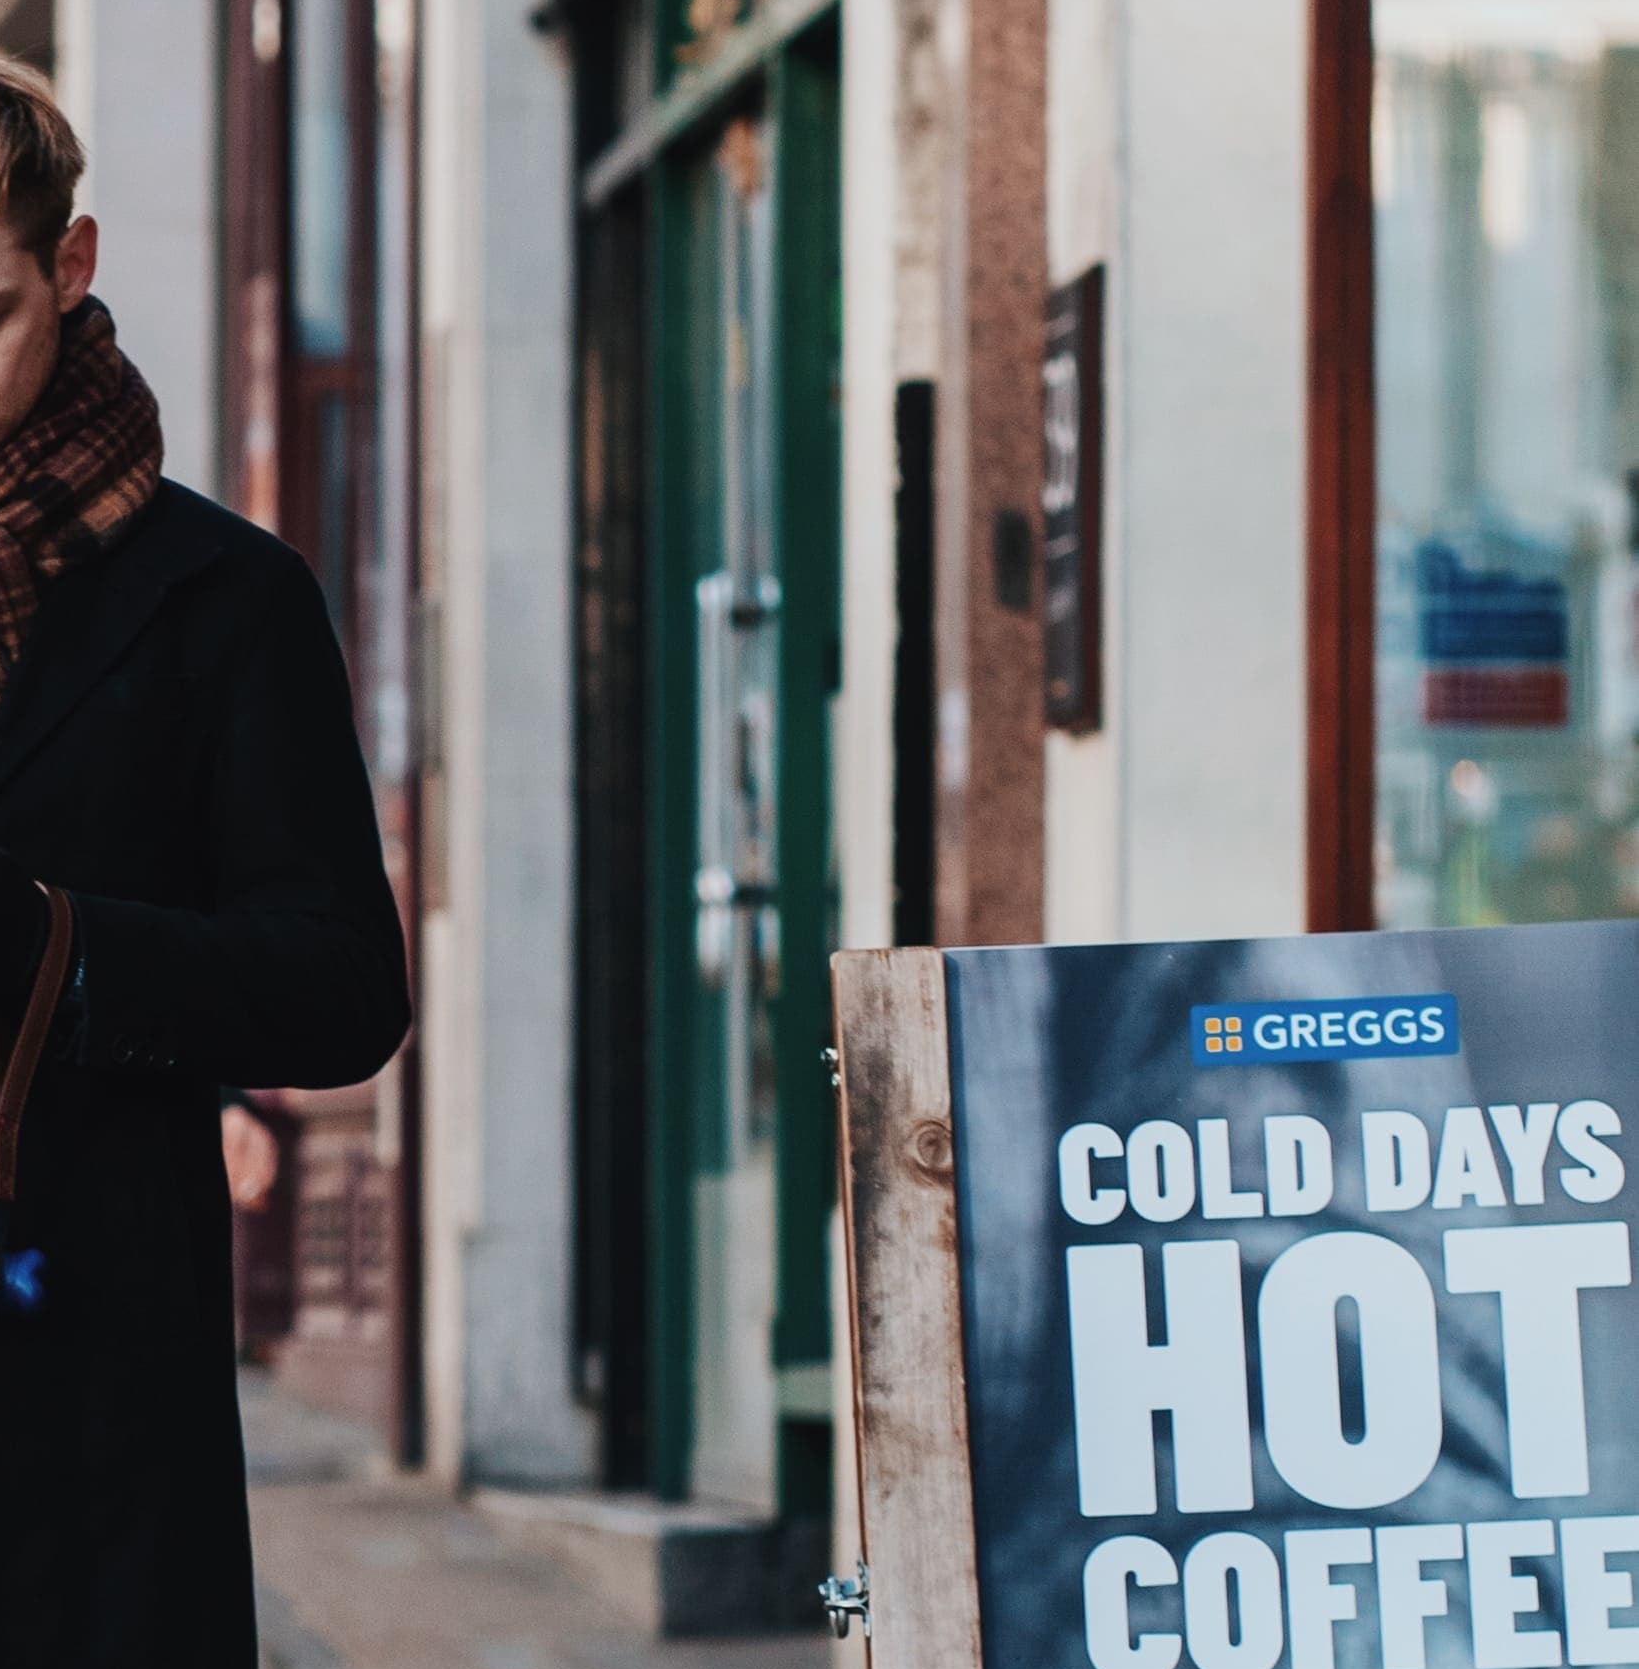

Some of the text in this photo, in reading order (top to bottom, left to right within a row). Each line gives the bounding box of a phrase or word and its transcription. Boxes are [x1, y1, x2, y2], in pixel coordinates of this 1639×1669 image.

[1253, 1007, 1445, 1050] GREGGS
[1057, 1099, 1626, 1225] COLD DAYS
[1065, 1221, 1632, 1518] HOT
